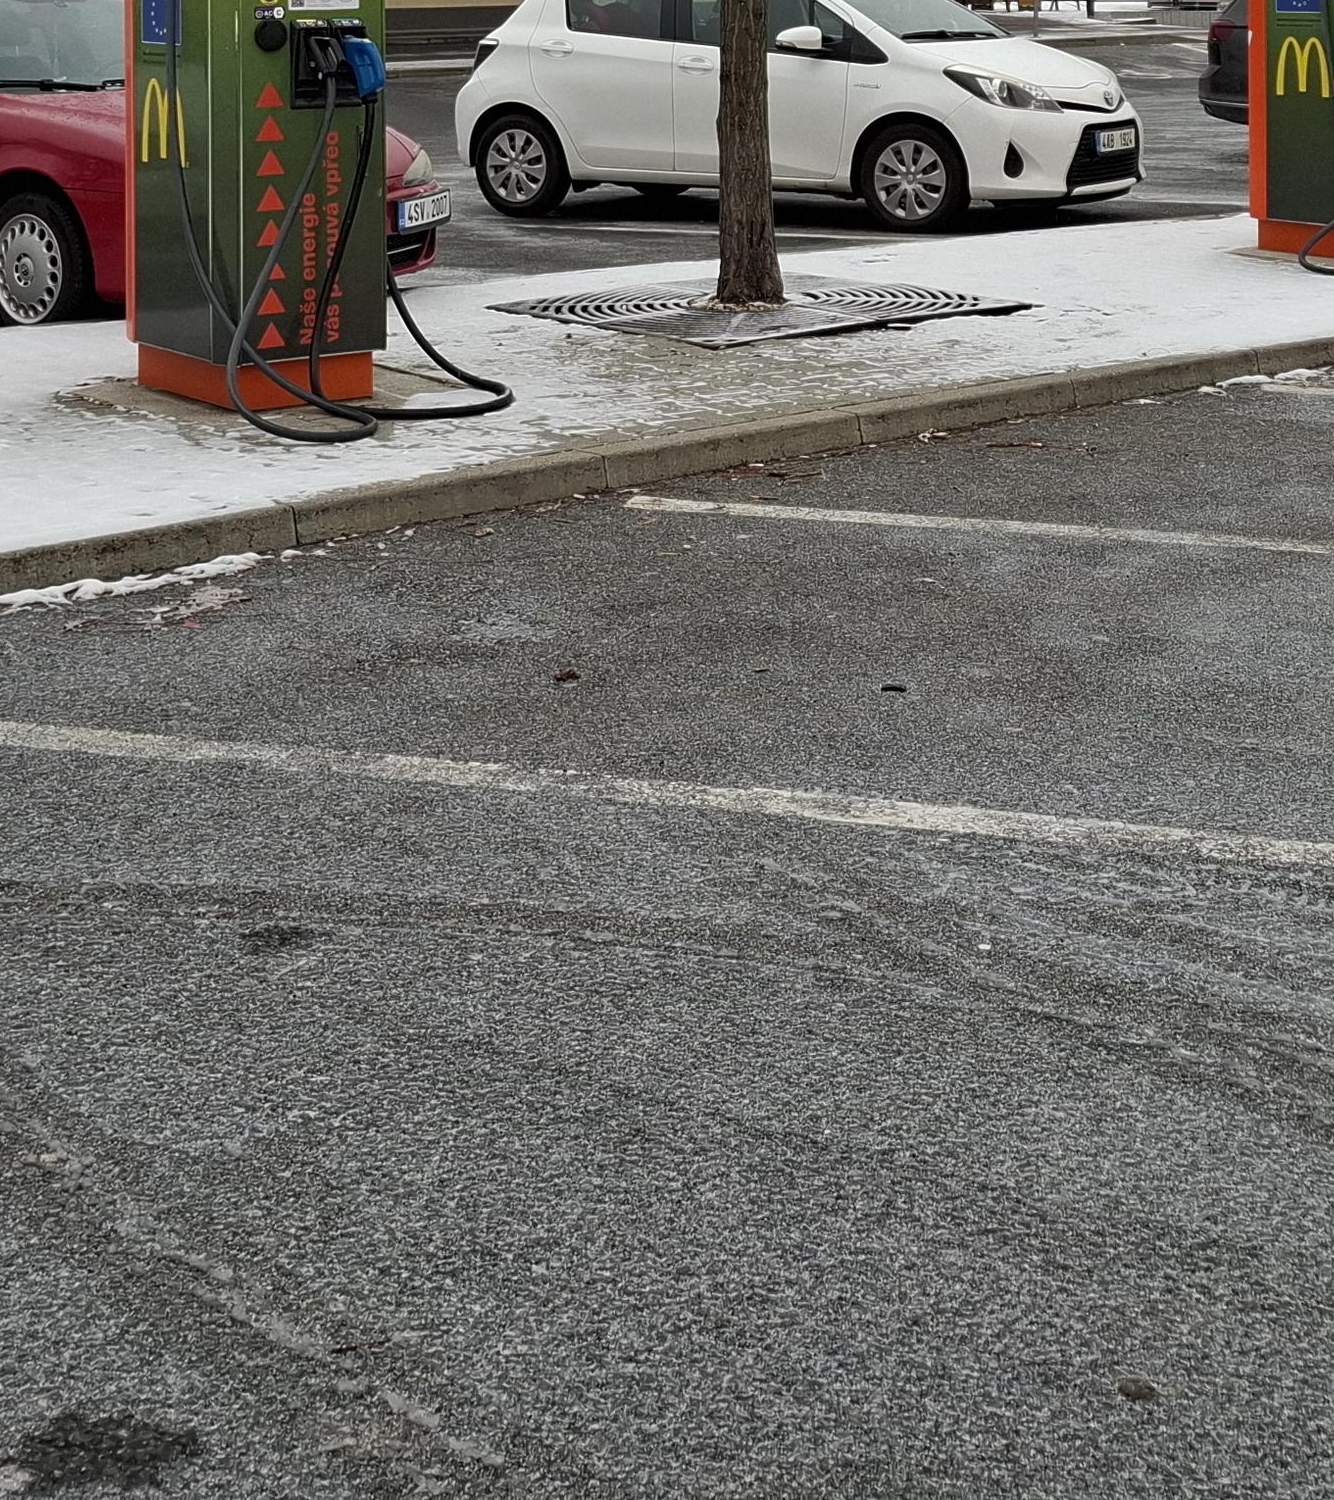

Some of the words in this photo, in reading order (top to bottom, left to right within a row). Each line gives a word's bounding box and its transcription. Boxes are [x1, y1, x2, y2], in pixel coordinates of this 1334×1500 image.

[299, 192, 319, 281] energie
[408, 201, 426, 223] 4SV
[299, 287, 317, 346] Naše
[323, 303, 341, 343] vás
